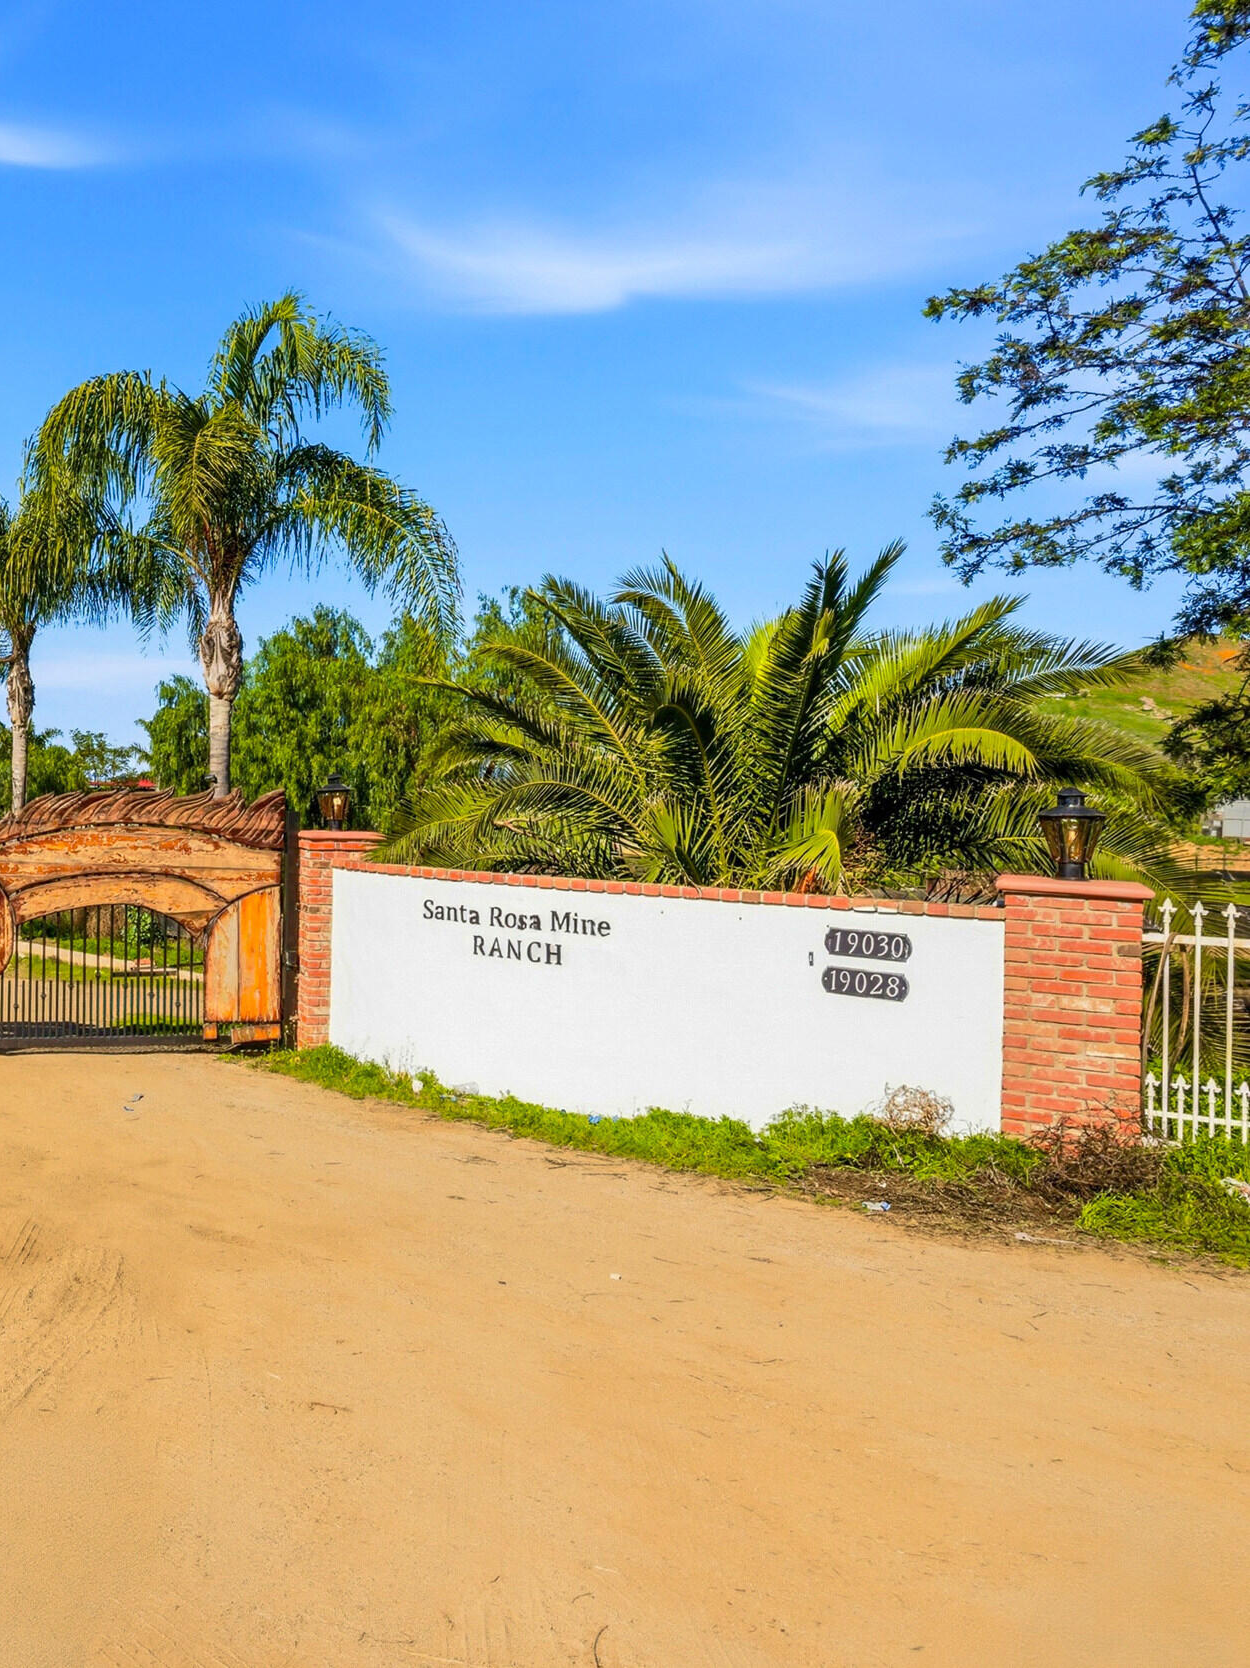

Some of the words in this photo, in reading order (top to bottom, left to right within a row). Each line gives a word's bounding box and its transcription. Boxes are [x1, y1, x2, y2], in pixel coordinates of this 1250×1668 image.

[423, 899, 480, 925] Santa
[489, 906, 542, 931] Rosa
[550, 910, 611, 937] Mine
[473, 935, 563, 966] RANCH
[834, 931, 904, 959] 19030
[830, 969, 900, 998] 19028
